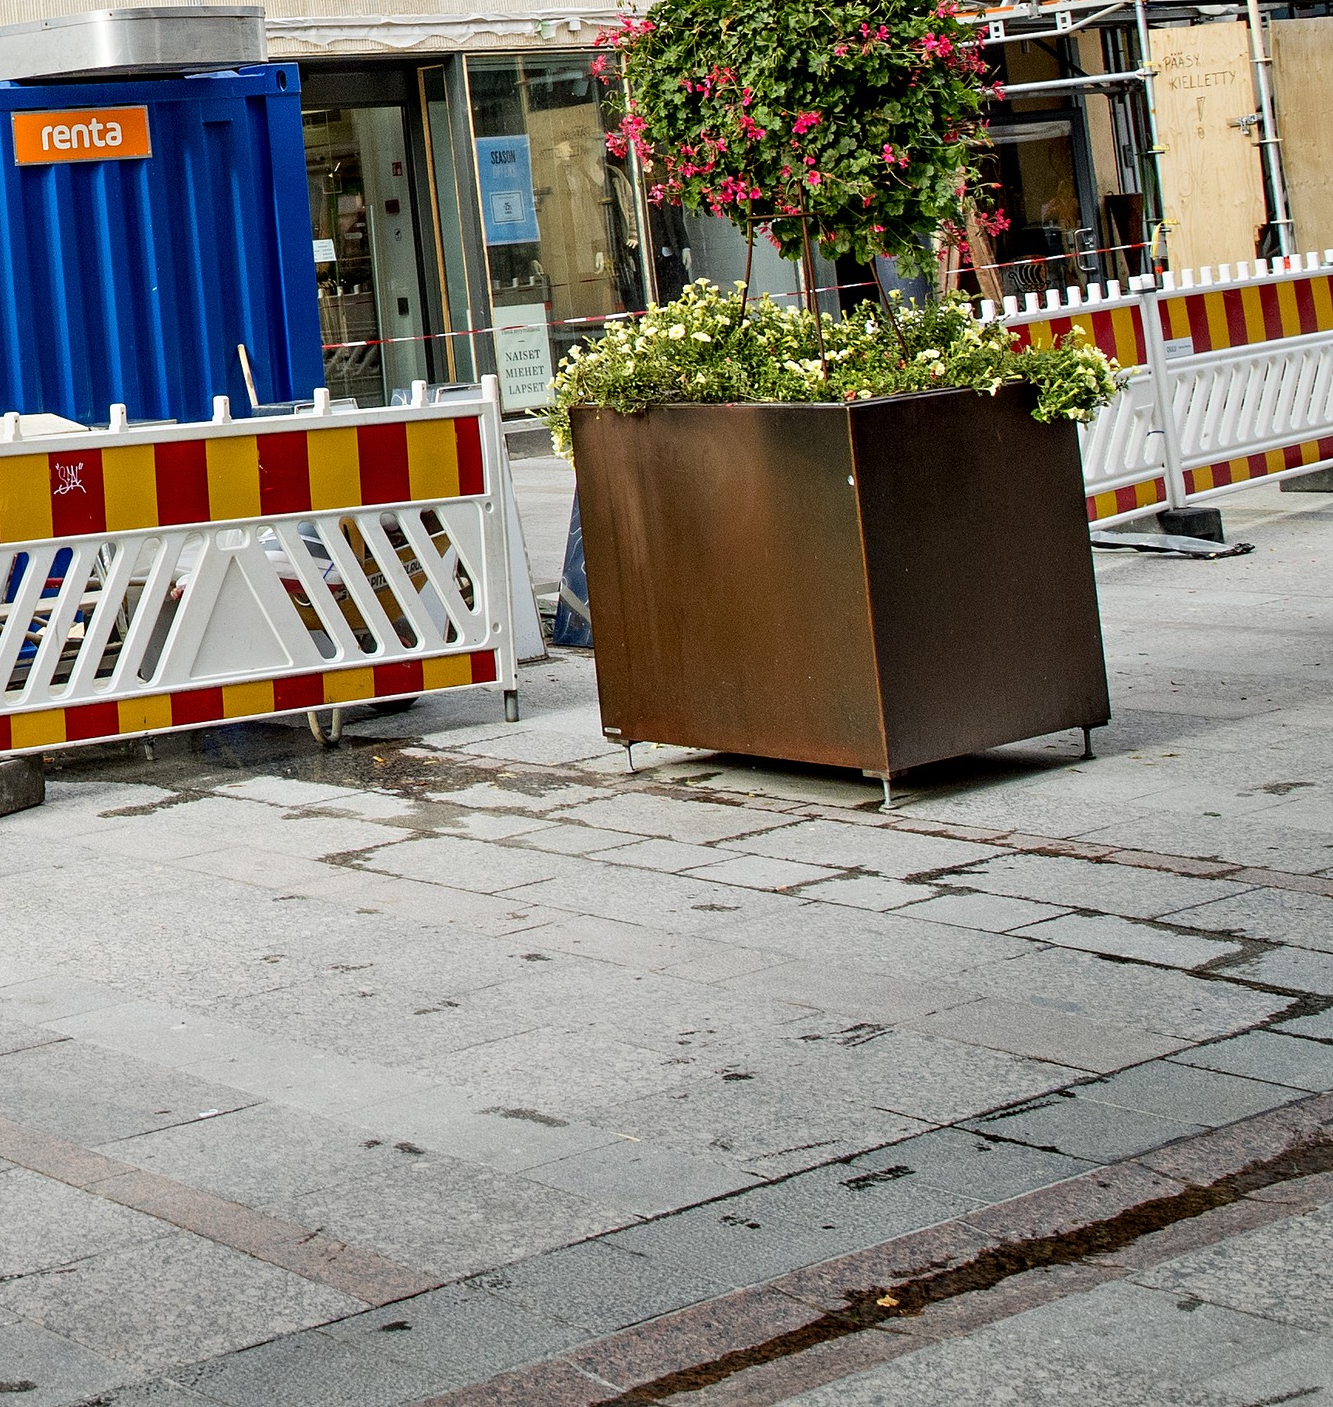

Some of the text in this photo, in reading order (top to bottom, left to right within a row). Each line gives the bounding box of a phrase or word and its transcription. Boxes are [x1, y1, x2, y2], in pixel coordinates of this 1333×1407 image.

[1163, 51, 1200, 71] PÄÄSY
[1169, 70, 1236, 91] KIELLETTY
[40, 117, 123, 151] renta
[490, 149, 516, 165] SEASON
[505, 349, 541, 362] NAISET
[505, 365, 545, 379] MIEHET
[508, 382, 545, 395] LAPSET
